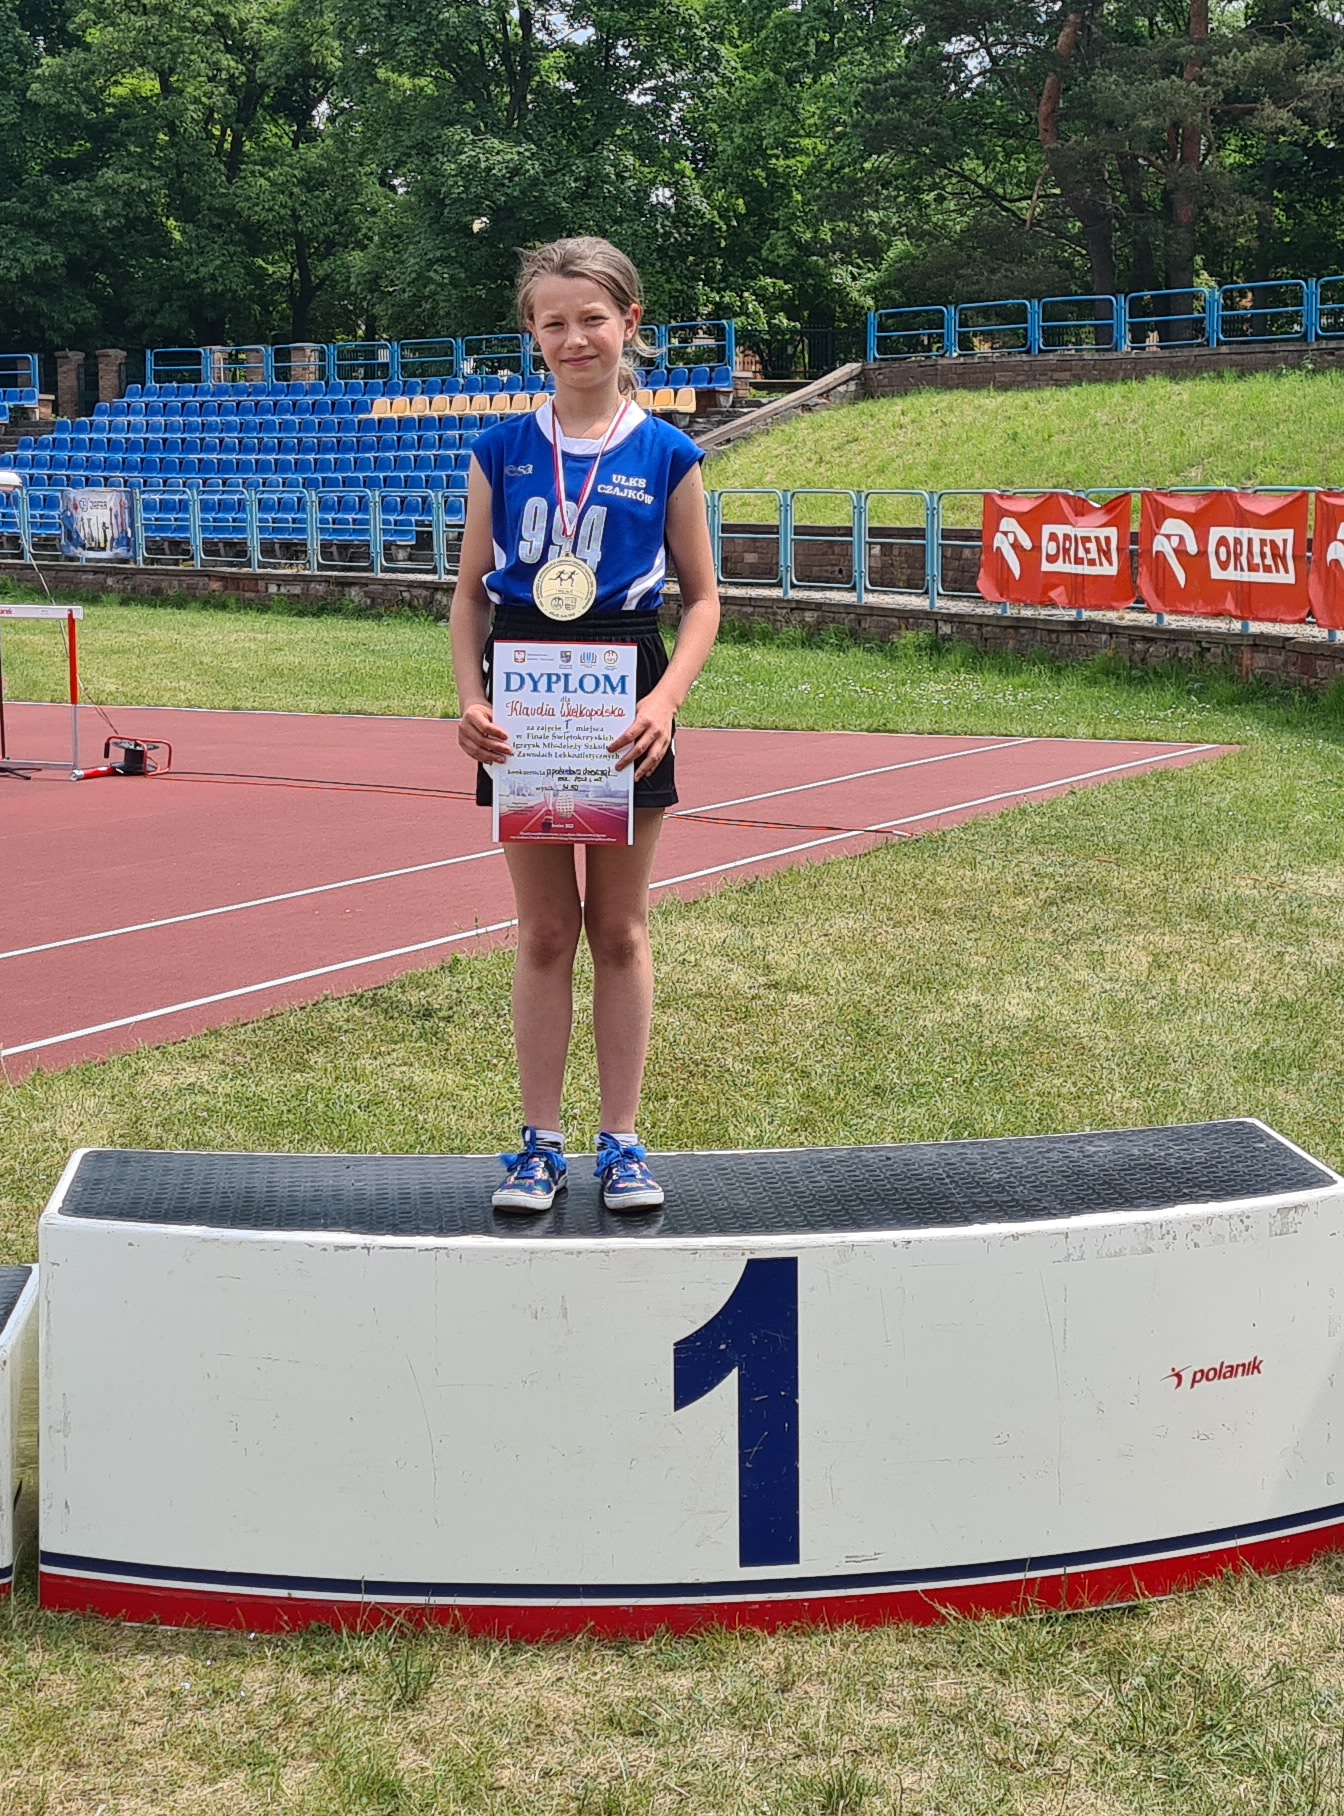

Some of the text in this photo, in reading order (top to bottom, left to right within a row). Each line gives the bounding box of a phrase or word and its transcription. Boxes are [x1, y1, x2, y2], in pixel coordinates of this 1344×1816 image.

[597, 484, 654, 505] CZAJKÓW
[612, 474, 647, 488] ULKS
[518, 497, 607, 574] 994
[1045, 531, 1114, 567] ORLEN
[1215, 535, 1291, 575] ORLEN
[503, 672, 629, 695] DYPLOM
[505, 700, 556, 717] Klaudia
[1190, 1356, 1264, 1389] polanik
[673, 1257, 800, 1568] 1
